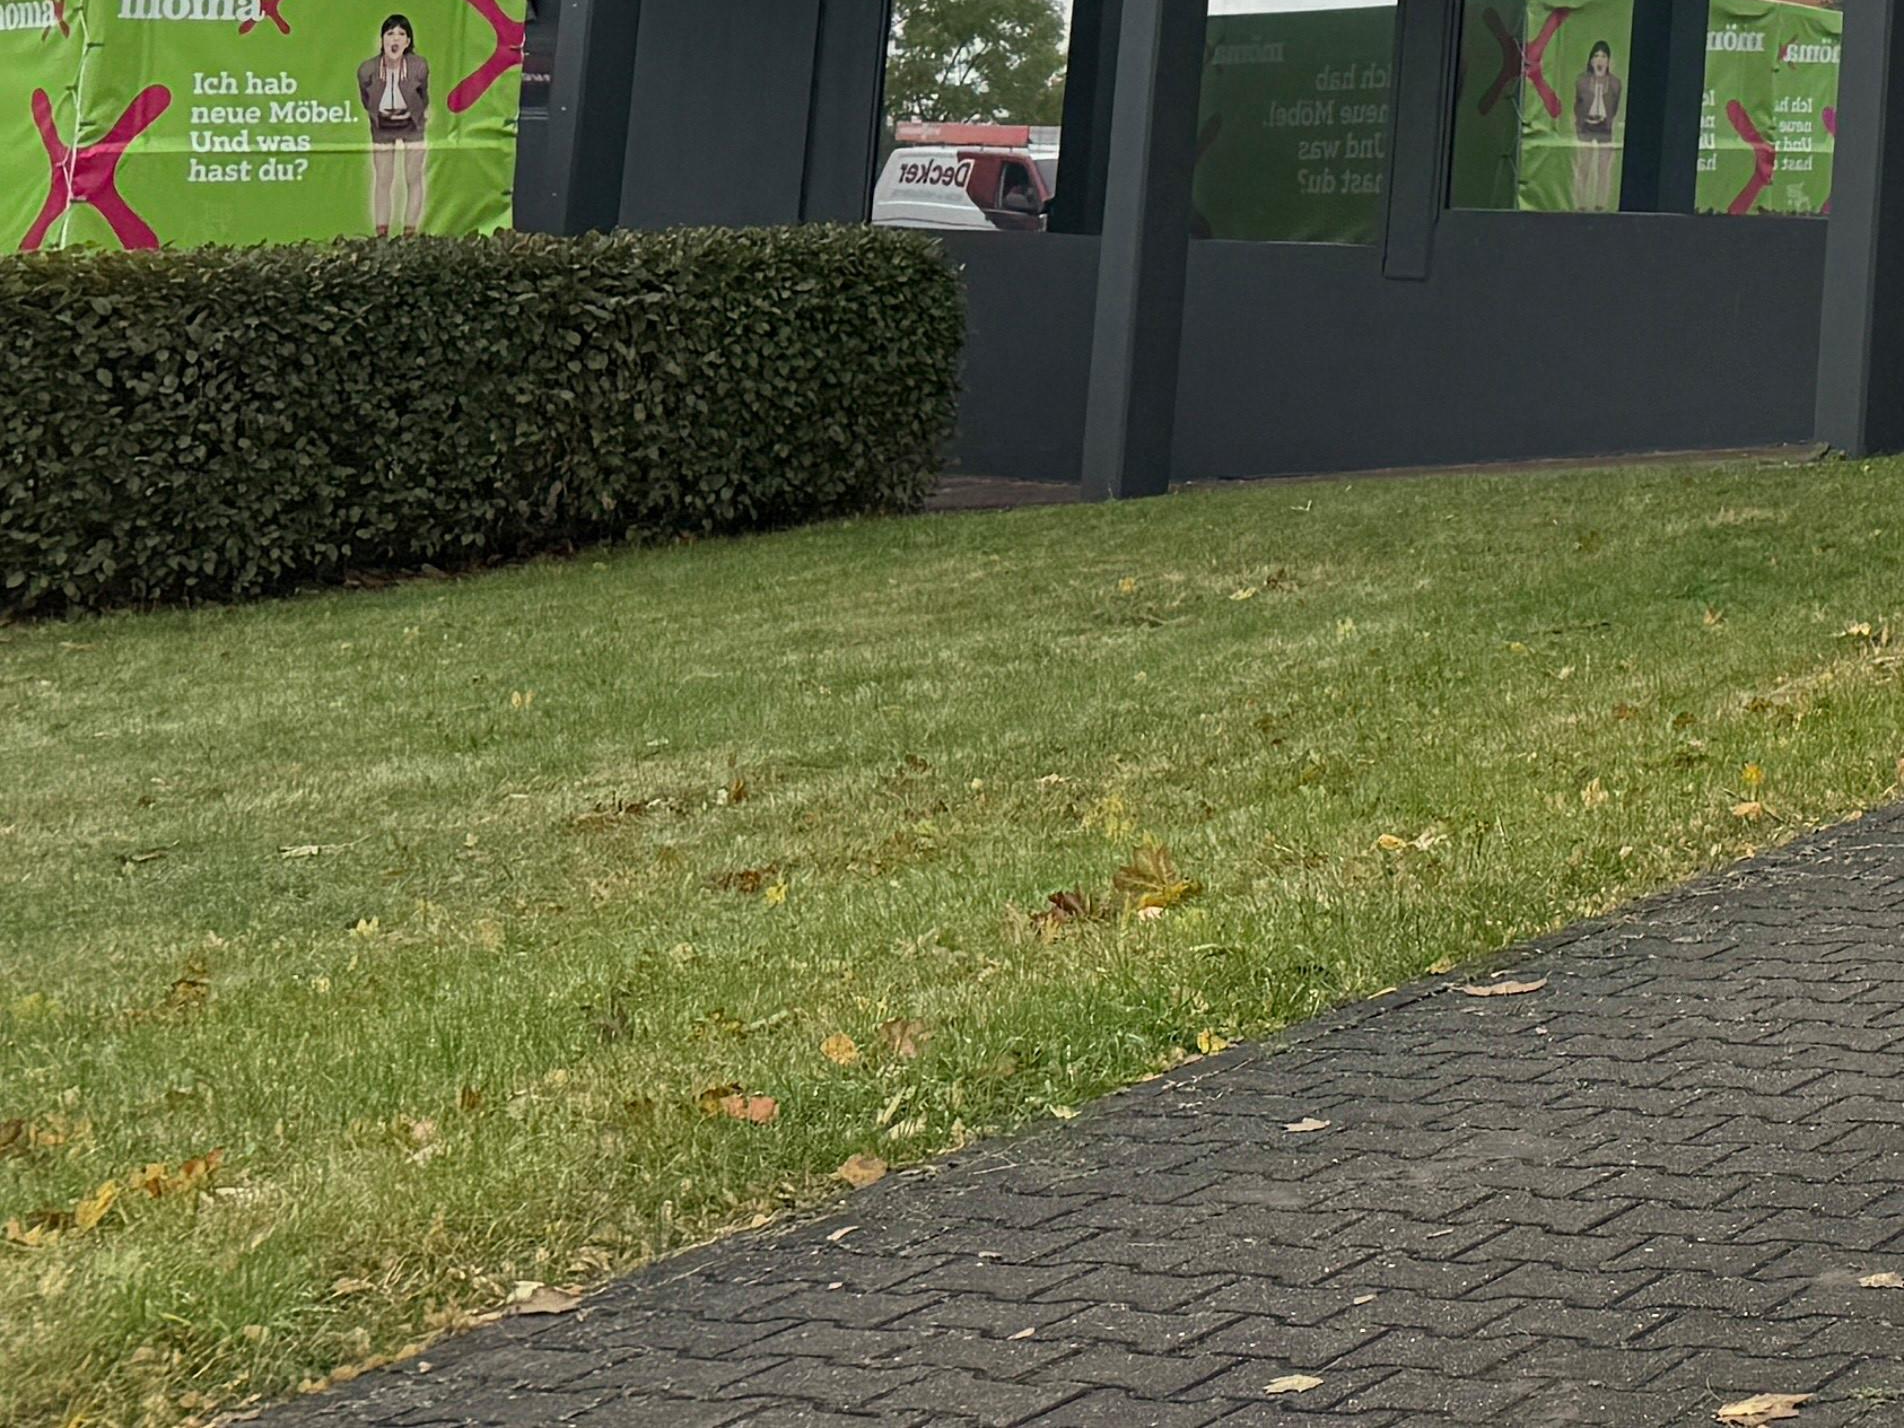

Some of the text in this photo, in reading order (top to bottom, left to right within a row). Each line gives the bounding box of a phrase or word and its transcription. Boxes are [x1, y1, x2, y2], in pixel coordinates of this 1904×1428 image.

[192, 71, 298, 95] Ich hab
[190, 100, 358, 124] neue Möbel.
[189, 129, 311, 153] Und was
[187, 158, 309, 182] hast du?
